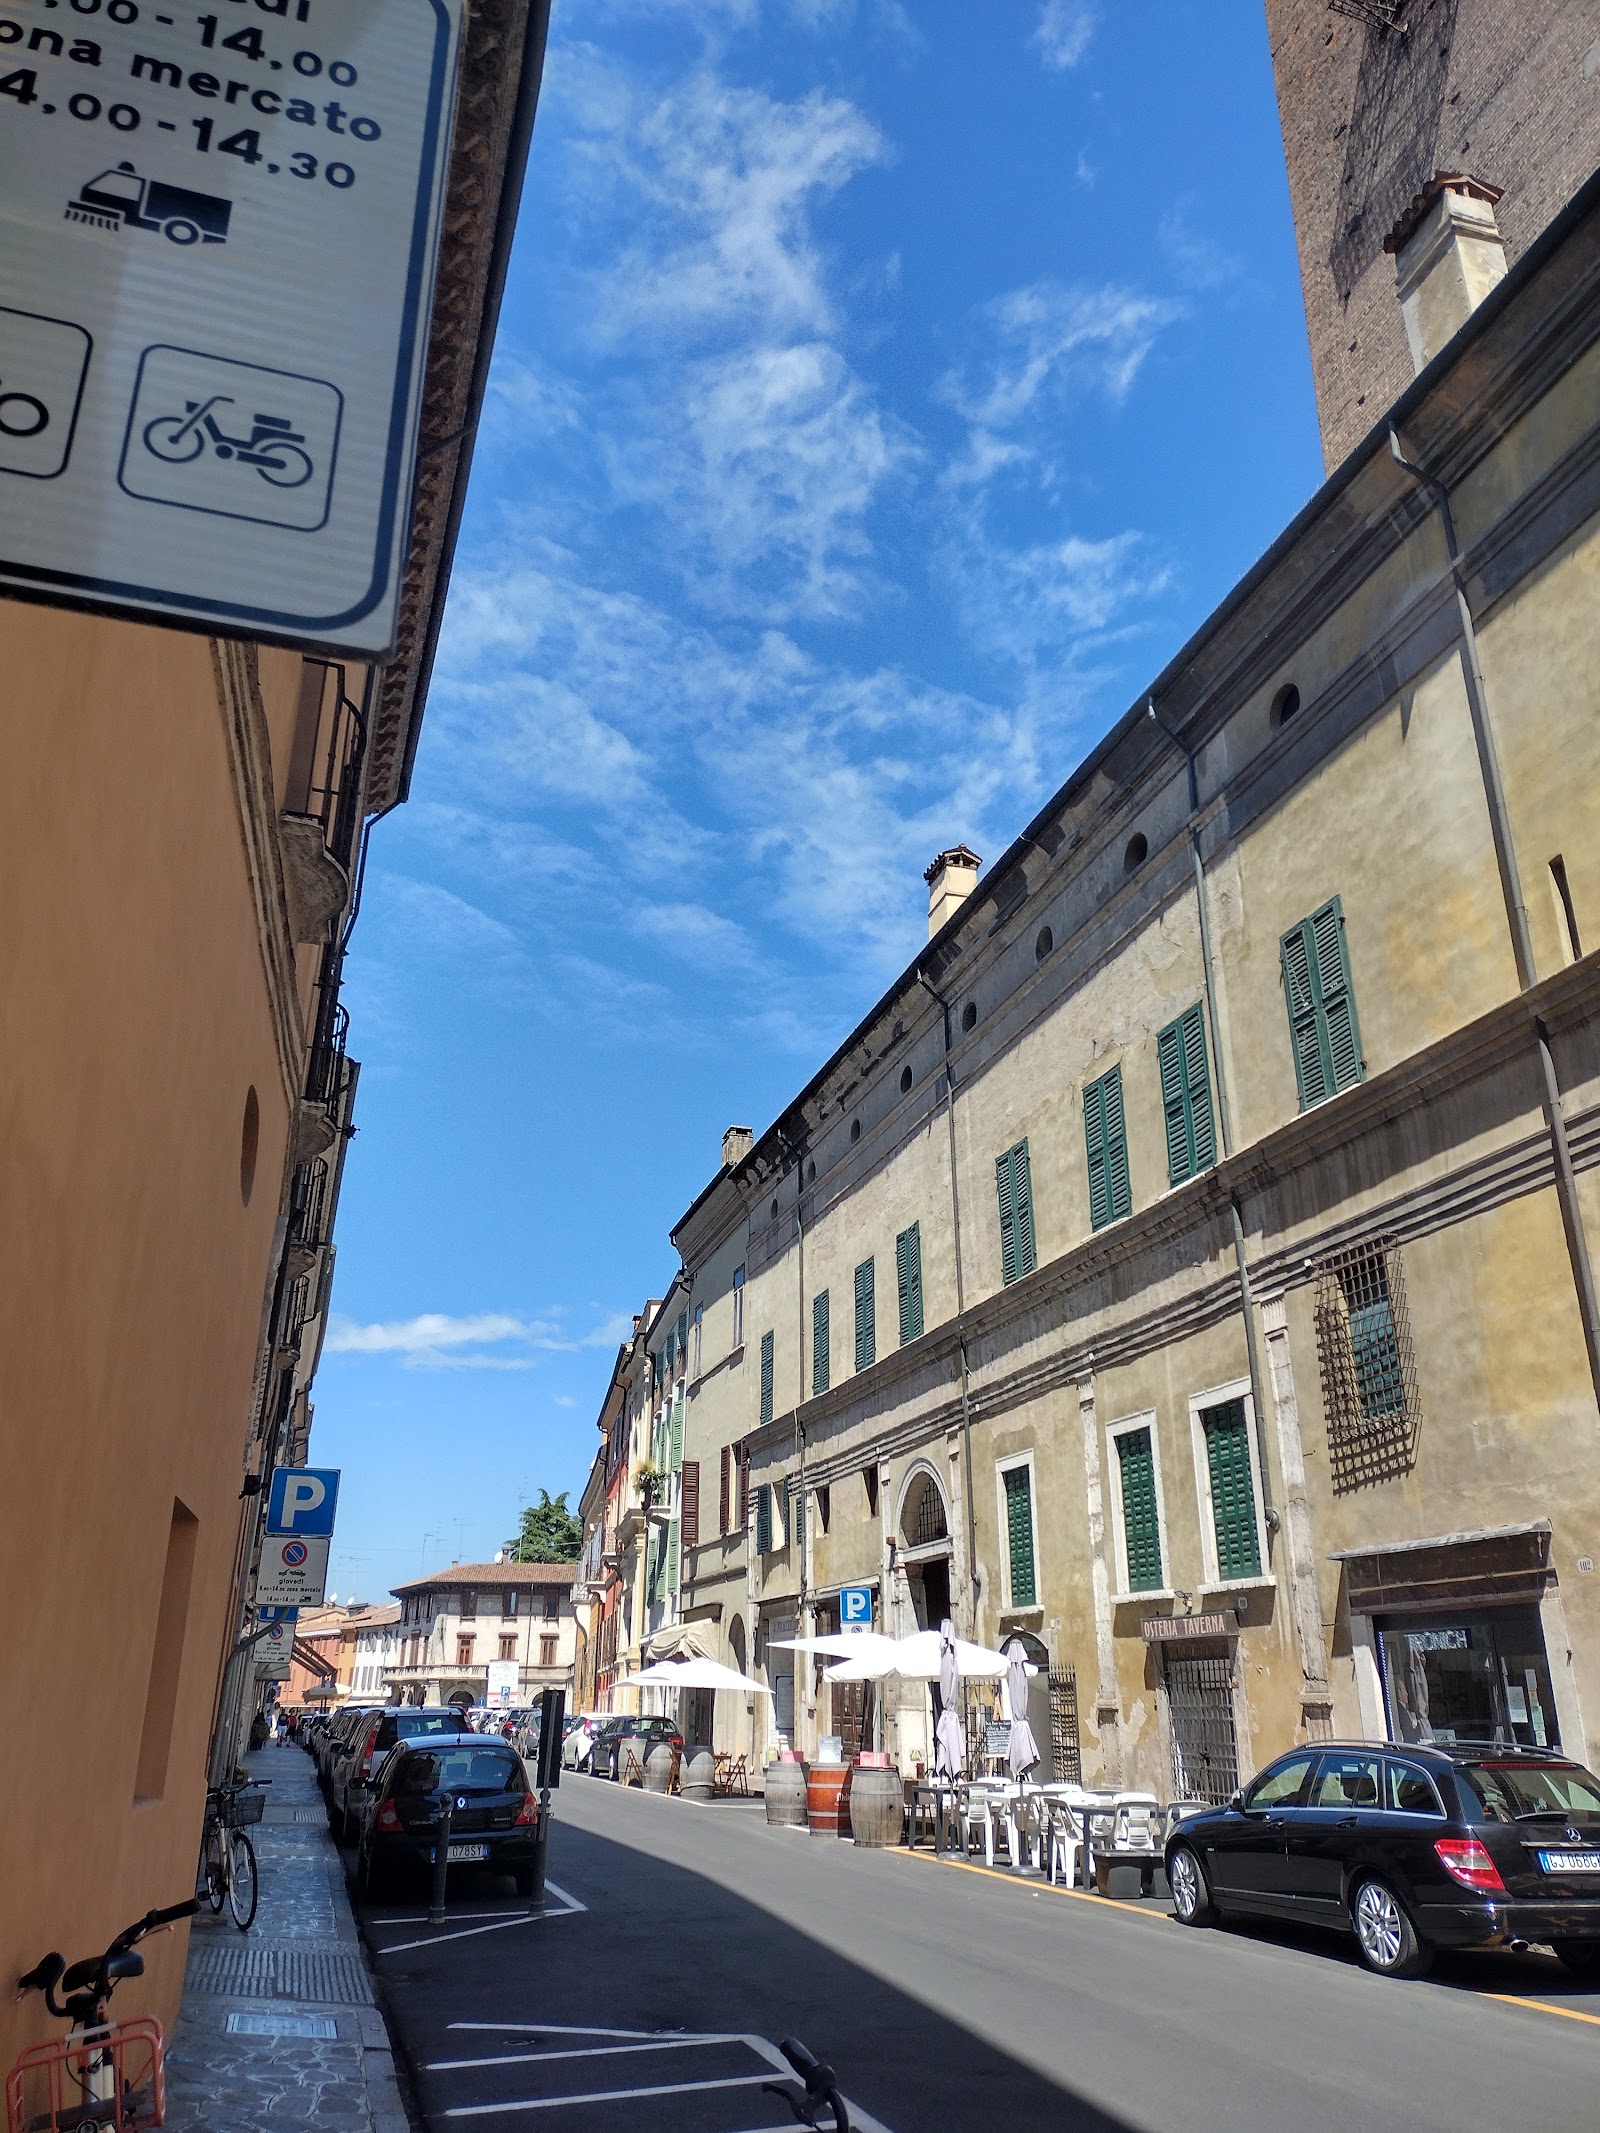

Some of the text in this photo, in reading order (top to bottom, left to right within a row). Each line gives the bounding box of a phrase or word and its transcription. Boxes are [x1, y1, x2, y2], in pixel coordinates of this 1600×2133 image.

[130, 54, 382, 142] mercato
[280, 1474, 326, 1528] P
[1579, 1560, 1592, 1571] 102
[846, 1592, 866, 1619] P
[1144, 1614, 1226, 1638] OSTERIA TAVERNA
[502, 1687, 510, 1696] P
[452, 1845, 482, 1858] 078SY
